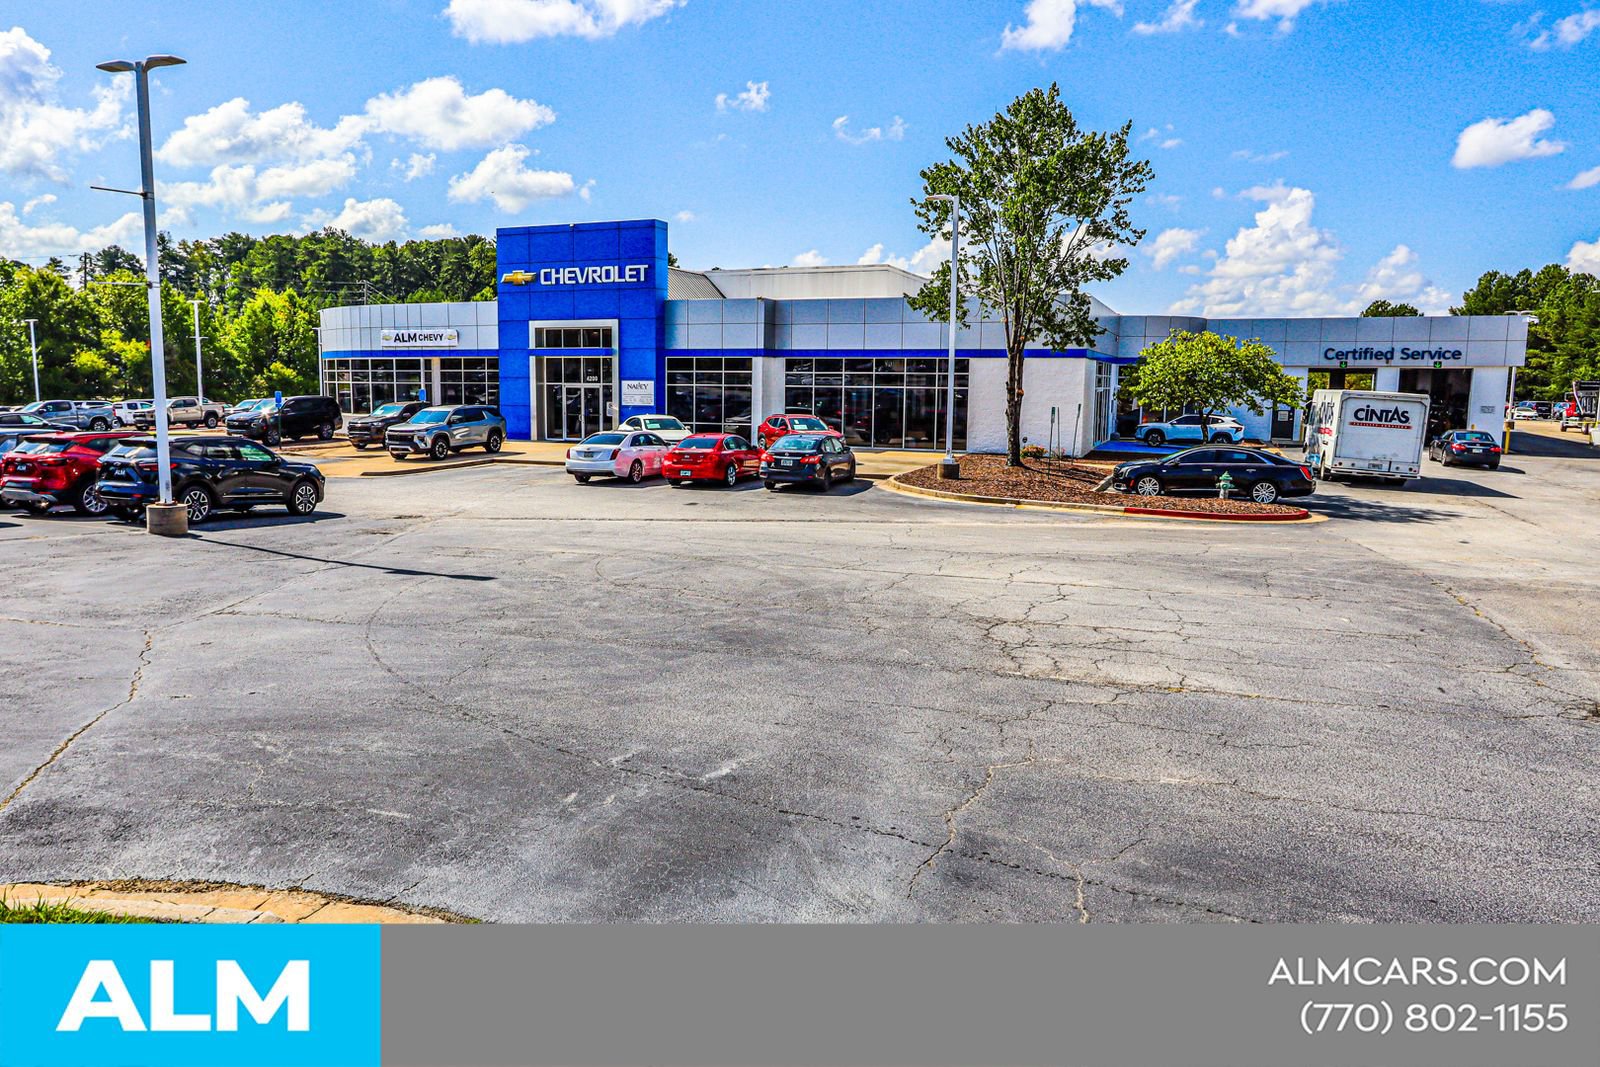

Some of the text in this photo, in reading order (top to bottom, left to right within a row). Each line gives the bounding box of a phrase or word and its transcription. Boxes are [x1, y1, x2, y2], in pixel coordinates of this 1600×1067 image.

[540, 264, 649, 285] CHEVROLET
[393, 332, 444, 343] ALM CHEVY
[1324, 347, 1462, 361] Certified Service
